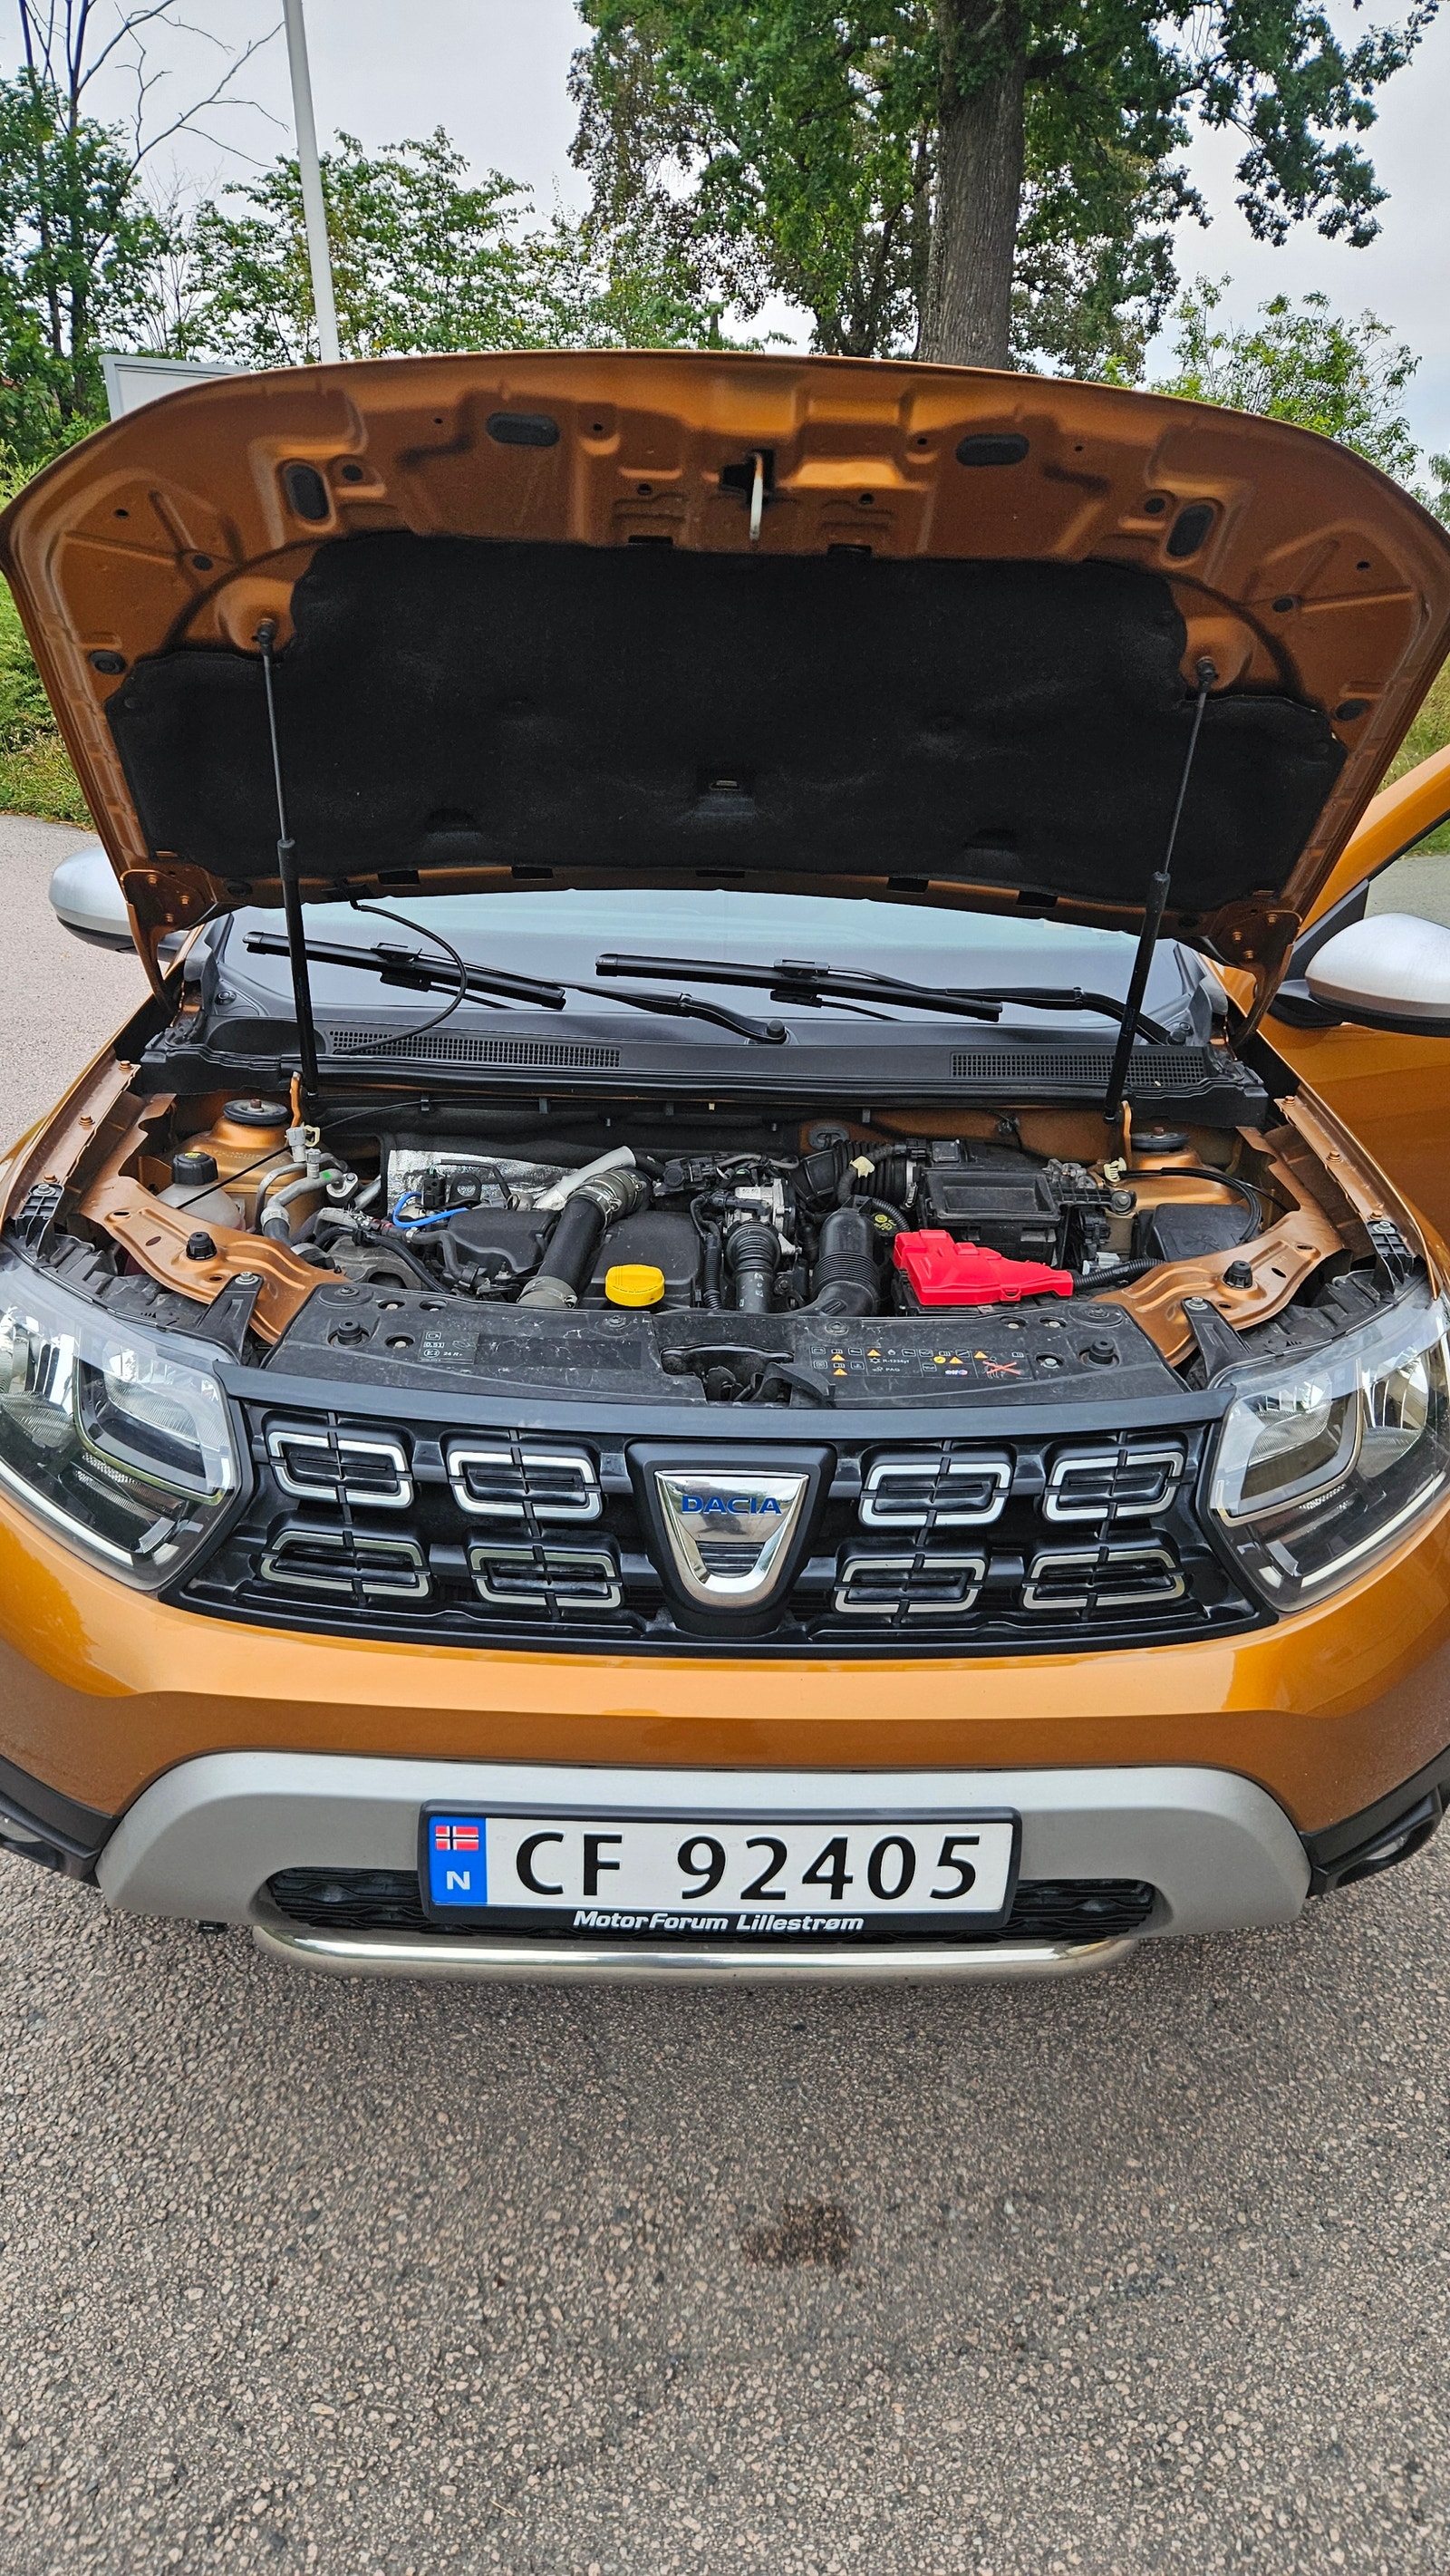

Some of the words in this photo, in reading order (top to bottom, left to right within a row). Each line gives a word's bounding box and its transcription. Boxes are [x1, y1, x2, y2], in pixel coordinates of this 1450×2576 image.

[681, 1496, 782, 1516] DACIA
[516, 1830, 624, 1897] CF
[676, 1834, 981, 1901] 92405
[446, 1871, 471, 1891] N
[736, 1913, 865, 1932] Lillestrøm
